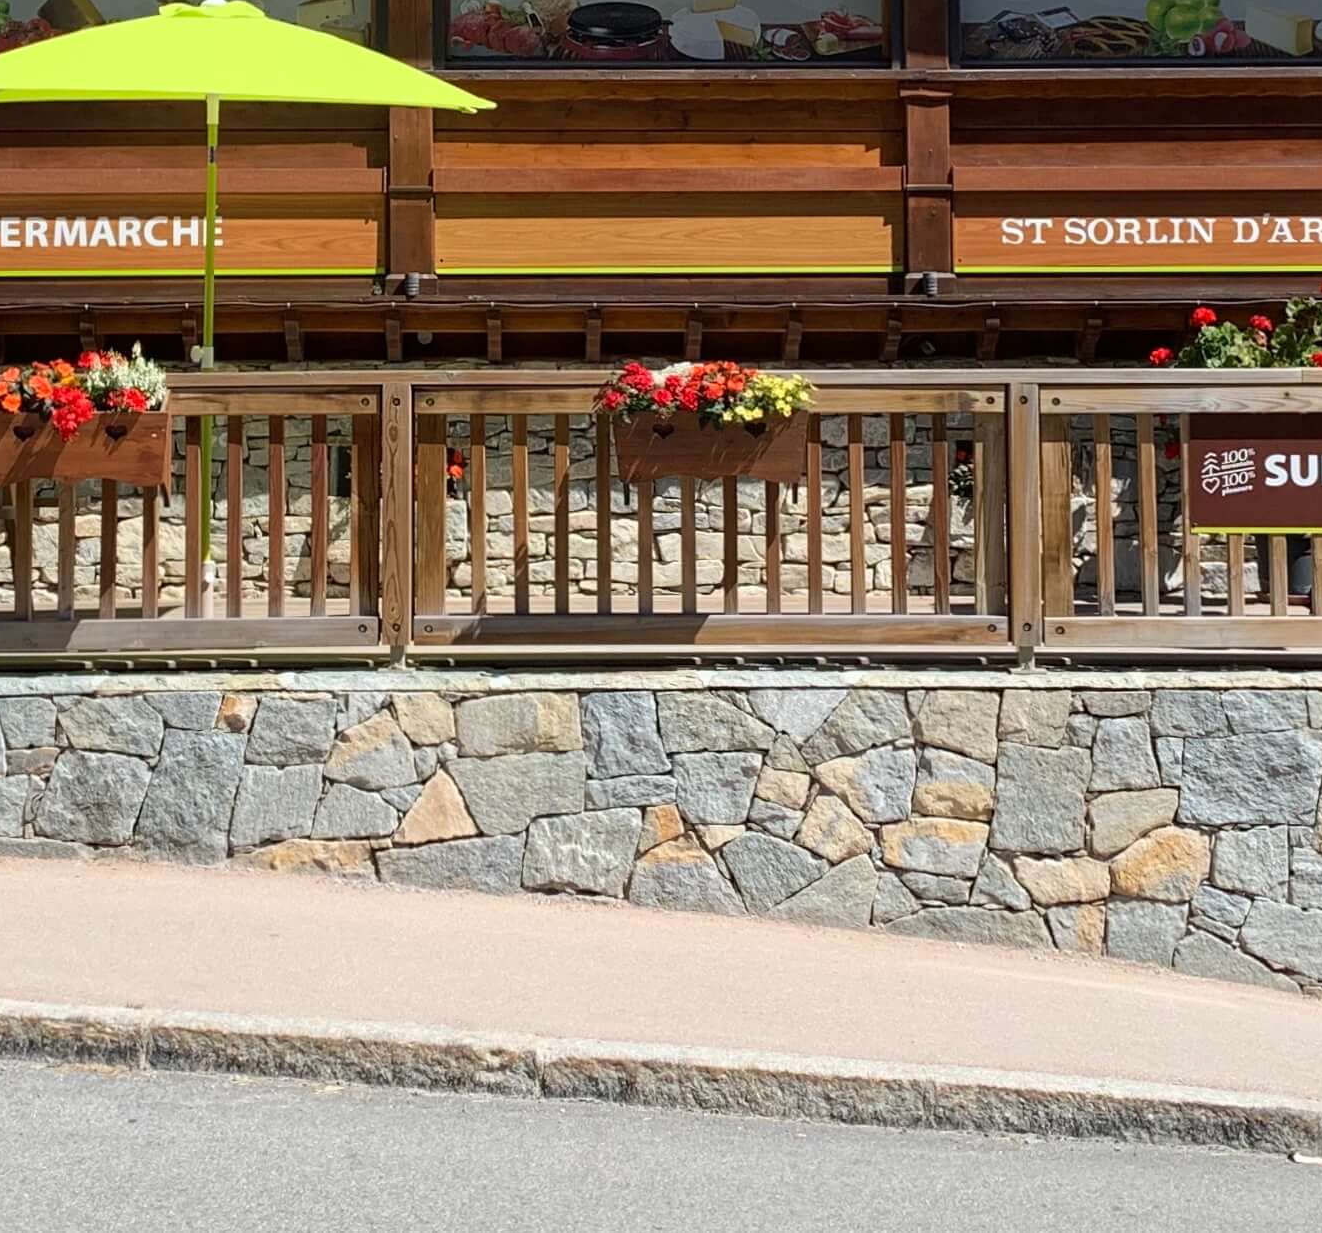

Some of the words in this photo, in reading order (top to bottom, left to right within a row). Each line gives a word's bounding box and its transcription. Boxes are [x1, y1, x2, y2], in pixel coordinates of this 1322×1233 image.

[1000, 217, 1053, 246] ST
[1064, 217, 1215, 246] SORLIN
[1220, 447, 1256, 465] 100%
[1221, 470, 1256, 488] 100%
